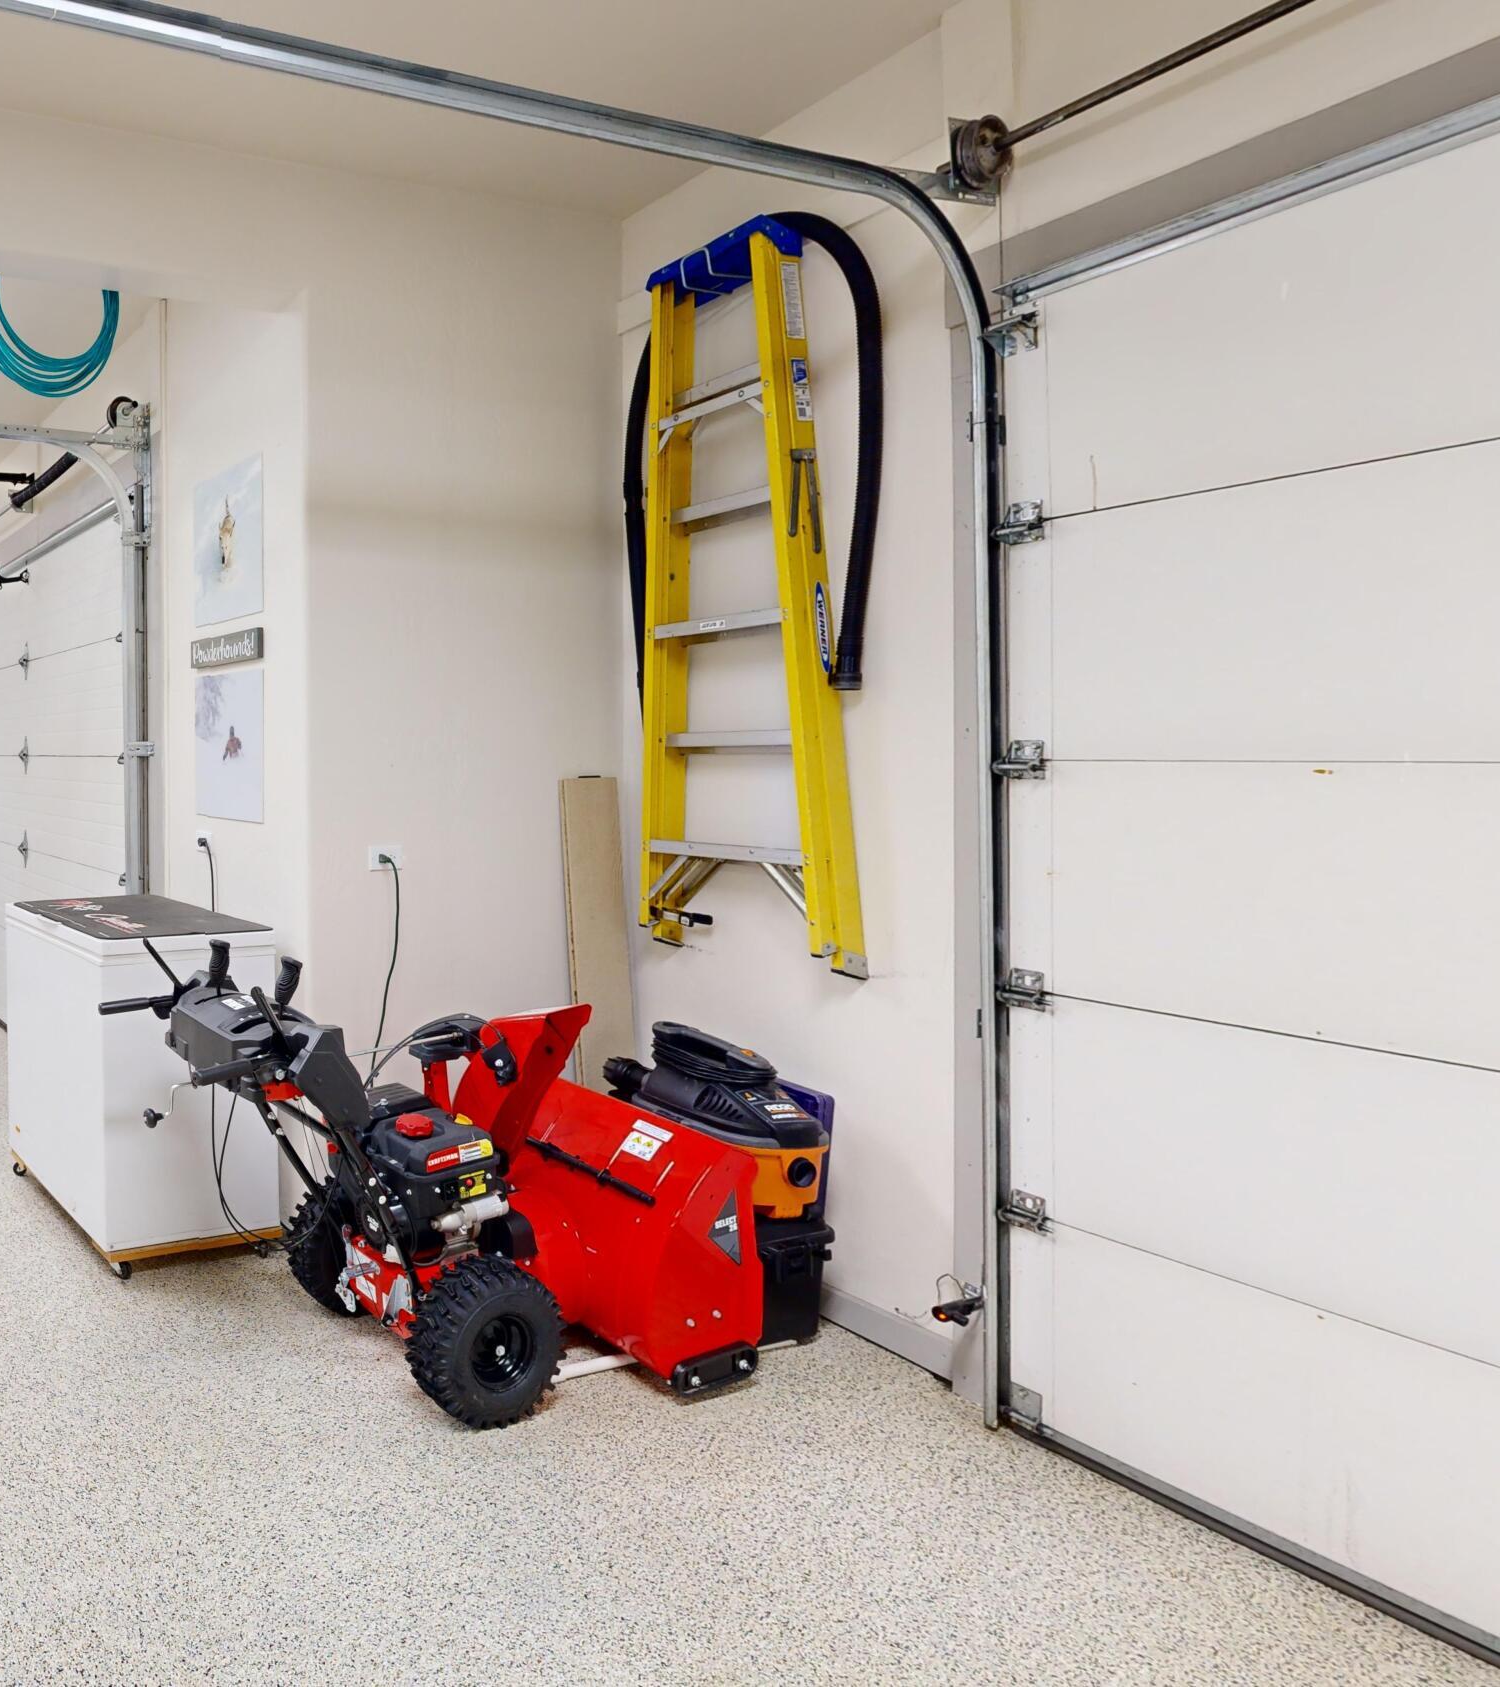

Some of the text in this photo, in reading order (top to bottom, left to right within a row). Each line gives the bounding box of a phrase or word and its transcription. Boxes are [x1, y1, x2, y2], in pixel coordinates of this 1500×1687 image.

[816, 600, 828, 655] WERNER
[192, 631, 255, 665] Powderhounds!
[714, 1215, 738, 1229] SELECT
